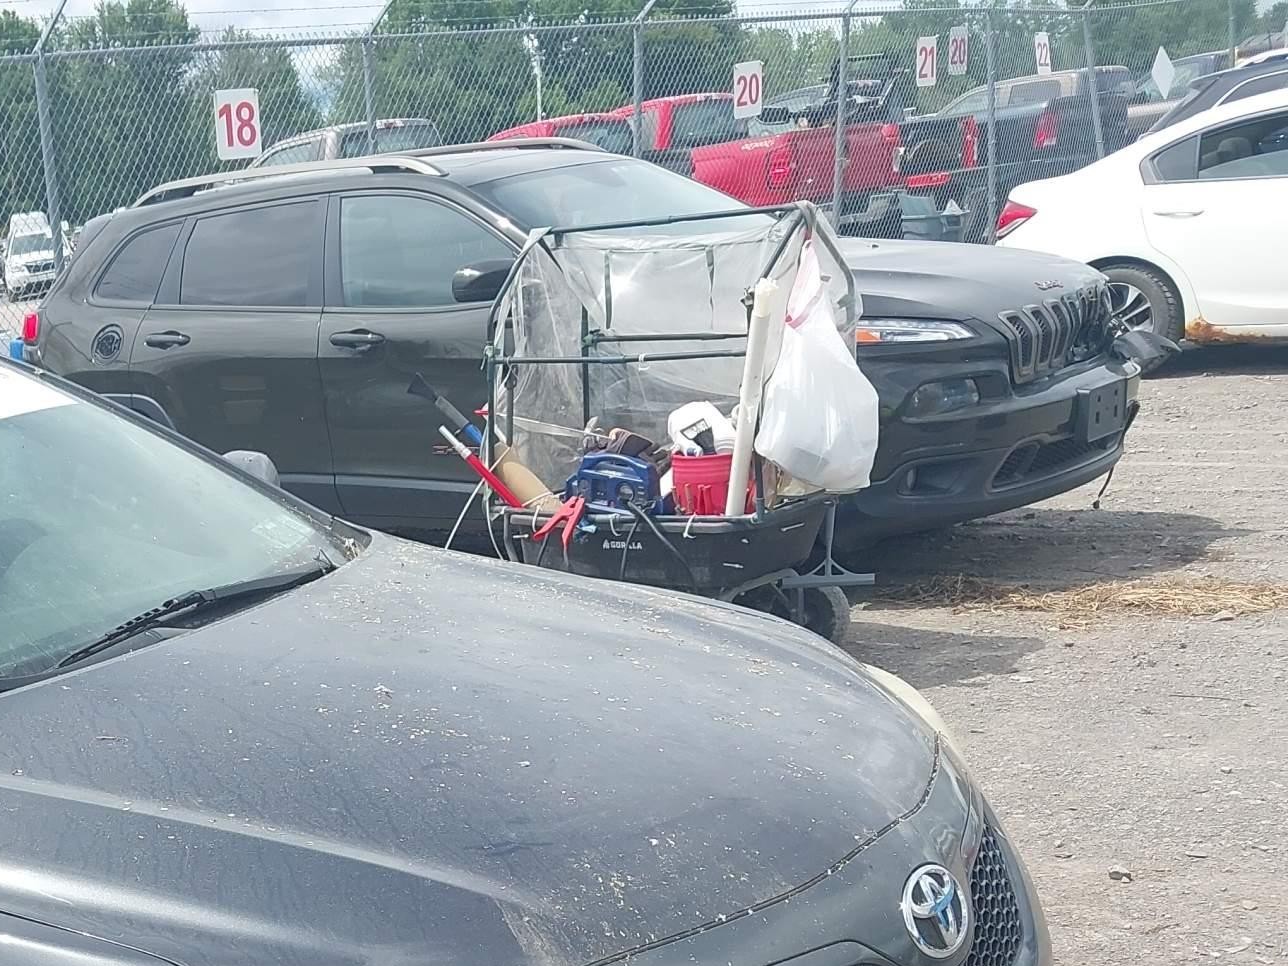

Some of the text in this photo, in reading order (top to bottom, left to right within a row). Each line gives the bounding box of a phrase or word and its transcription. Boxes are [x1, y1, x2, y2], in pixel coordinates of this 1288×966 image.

[918, 46, 935, 78] 21
[950, 39, 966, 65] 20
[1037, 43, 1050, 66] 22
[737, 74, 760, 107] 20
[218, 101, 257, 147] 18
